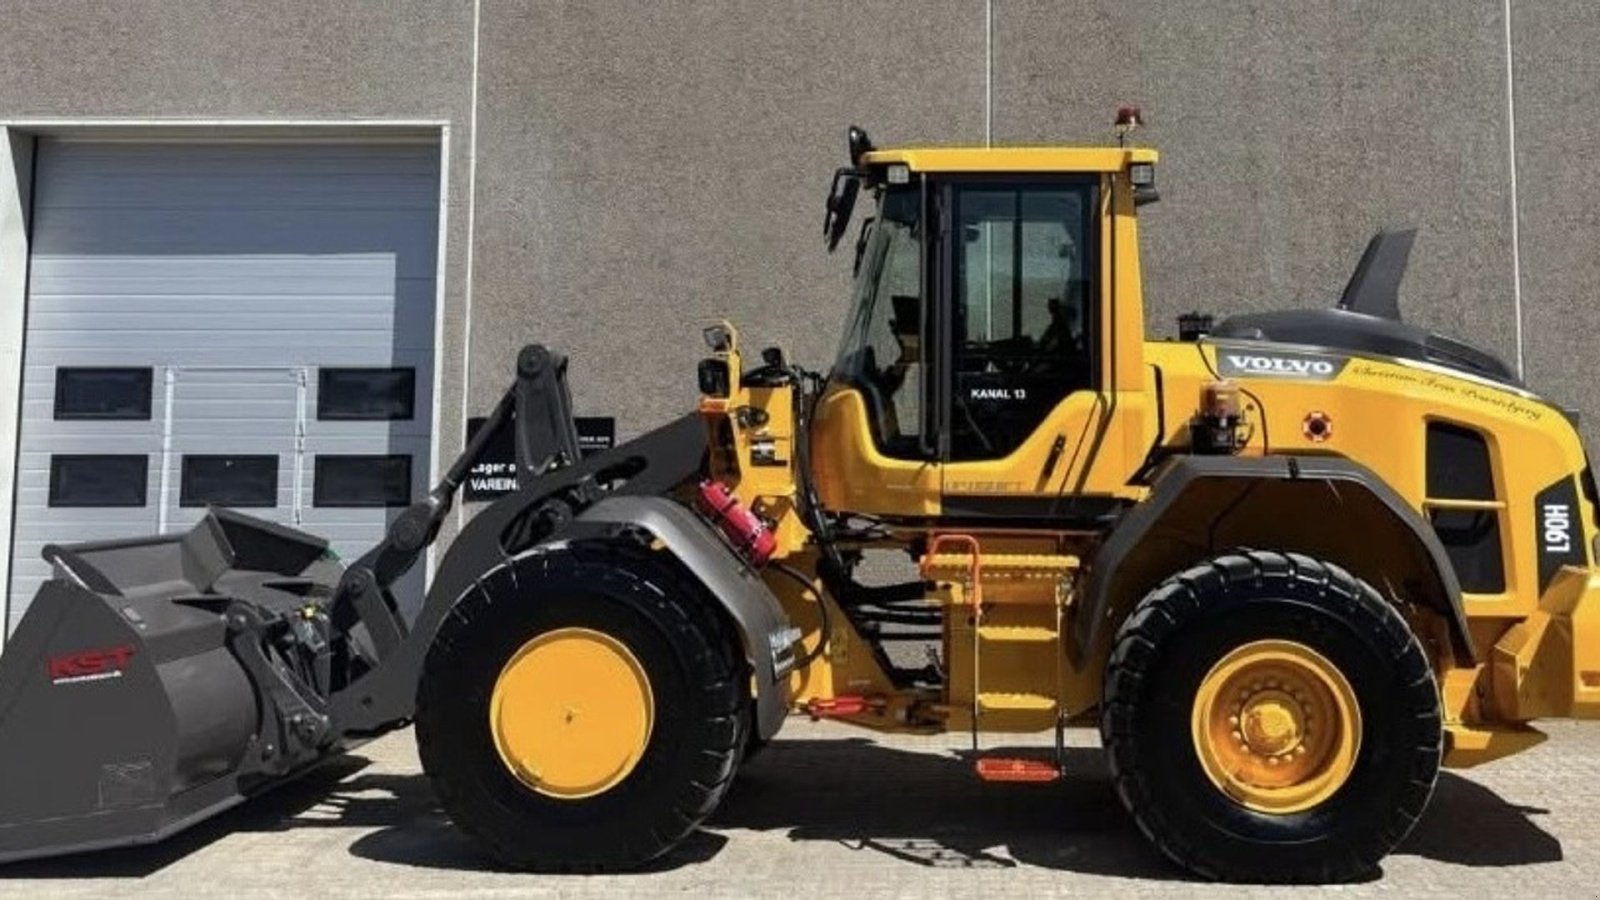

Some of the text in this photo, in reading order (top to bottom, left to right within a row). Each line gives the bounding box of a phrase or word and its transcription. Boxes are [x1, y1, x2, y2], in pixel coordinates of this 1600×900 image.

[1226, 355, 1334, 374] VOLVO
[971, 388, 1026, 400] KANAL 13
[470, 477, 520, 491] VAREIN
[1543, 504, 1571, 553] L90H
[48, 646, 134, 678] KST
